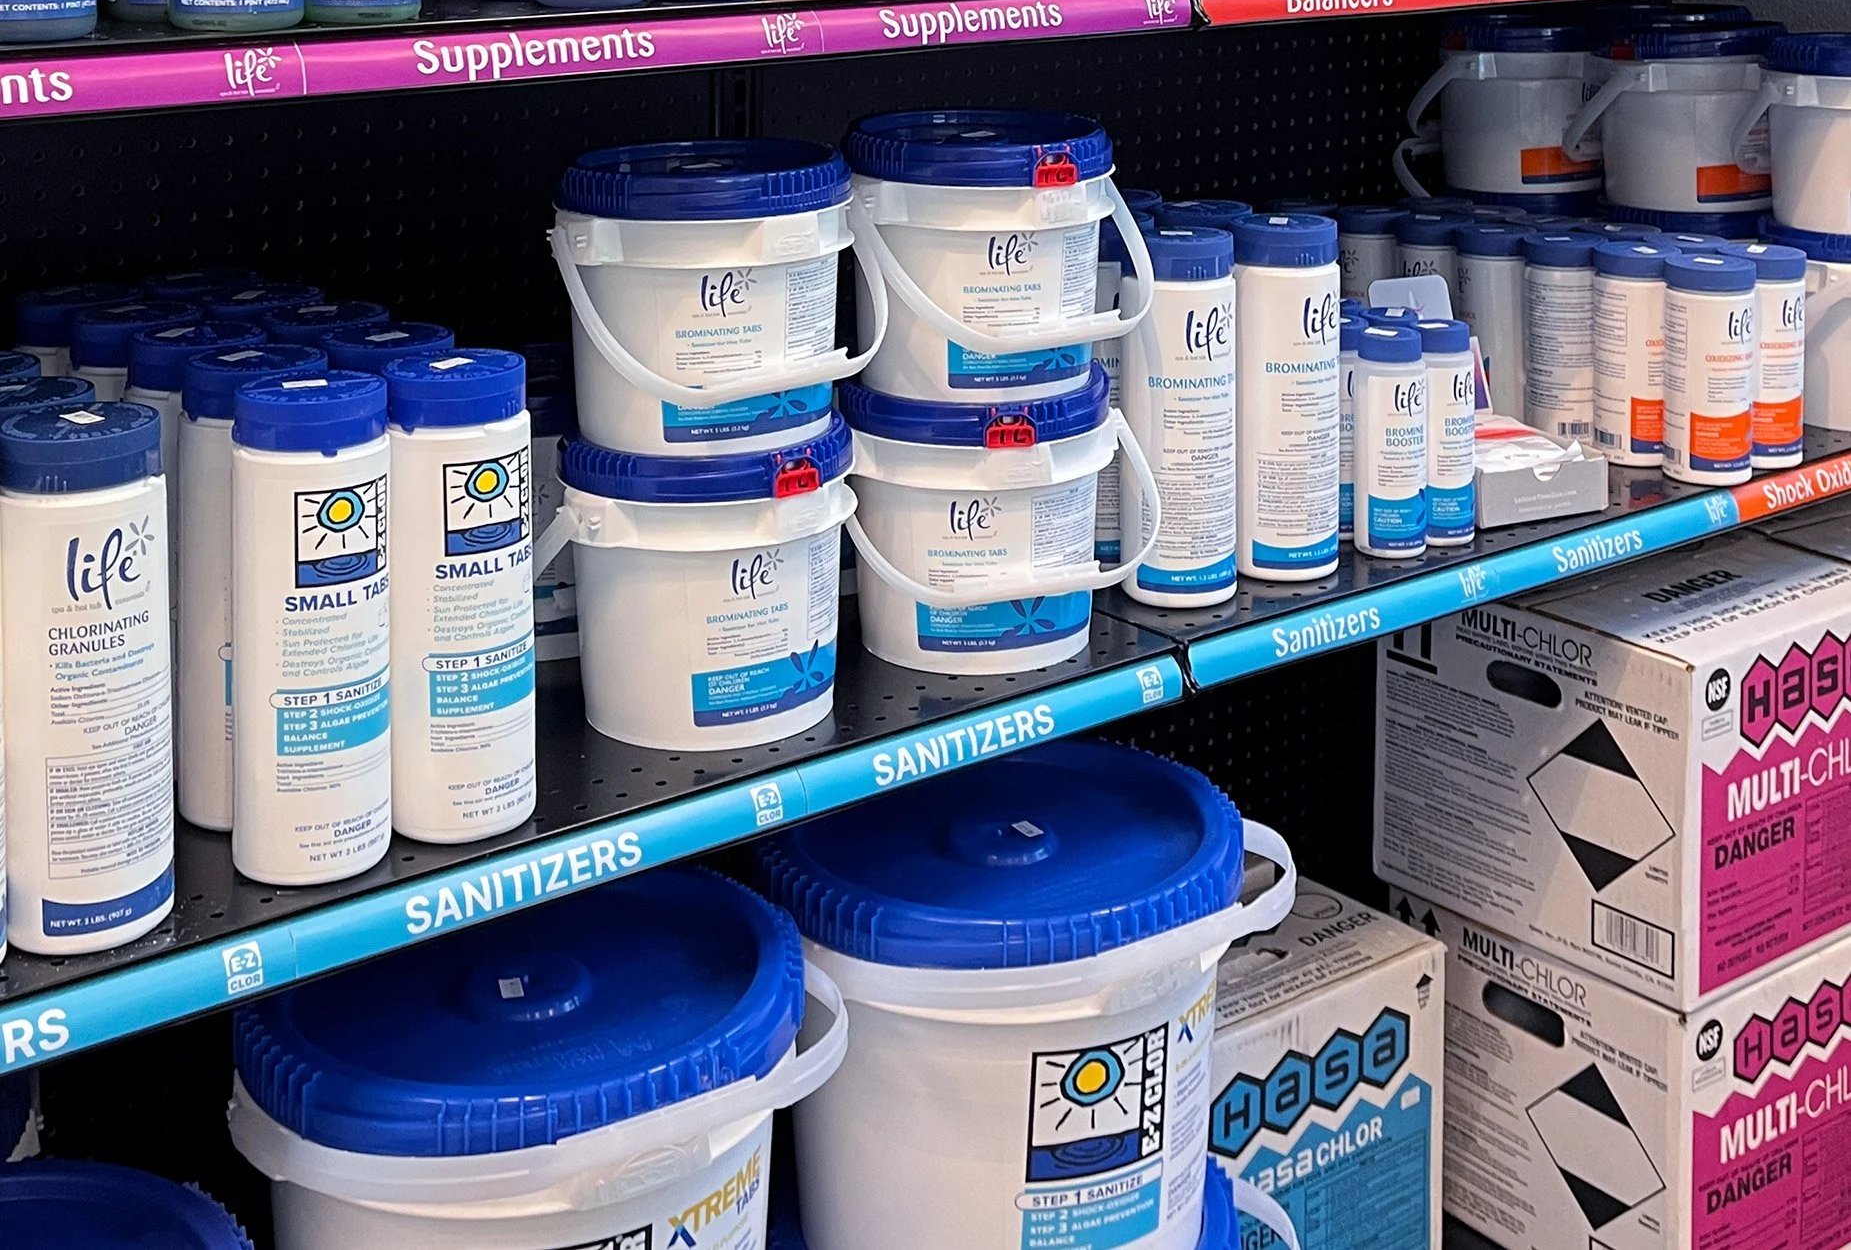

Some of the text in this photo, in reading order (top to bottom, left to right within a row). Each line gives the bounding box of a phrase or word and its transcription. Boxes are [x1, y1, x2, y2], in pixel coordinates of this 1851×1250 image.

[878, 1, 1063, 45] Supplements
[412, 28, 656, 82] Supplements
[988, 234, 1028, 276] life
[700, 270, 746, 317] life
[962, 282, 1042, 295] BROMINATING TABS
[1303, 293, 1338, 346] life
[675, 324, 763, 339] BROMINATING TABS
[1185, 307, 1228, 362] life
[1265, 358, 1336, 374] BROMINATING
[1148, 376, 1227, 390] BROMINATING
[1394, 381, 1422, 418] life
[1307, 433, 1331, 443] DANGER
[1385, 425, 1424, 438] BROMINE
[1385, 436, 1424, 448] BOOSTER
[1190, 452, 1219, 462] DANGER
[1762, 470, 1814, 511] Shock
[950, 500, 990, 541] life
[1373, 517, 1403, 525] CAUTION
[1432, 505, 1461, 514] CAUTION
[927, 547, 1008, 558] BROMINATING TABS
[1552, 527, 1643, 574] Sanitizers
[66, 527, 141, 611] life
[434, 557, 504, 580] SMALL
[731, 554, 774, 600] life
[1641, 568, 1743, 604] DANGER
[284, 590, 359, 613] SMALL
[706, 602, 789, 625] BROMINATING TABS
[929, 614, 963, 624] DANGER
[48, 609, 150, 642] CHLORINATING
[1271, 605, 1381, 659] Sanitizers
[1641, 615, 1714, 640] KEEP THIS
[1655, 630, 1692, 644] KEEP
[48, 633, 126, 657] GRANULES
[1460, 609, 1593, 668] MULTI-CHLOR
[436, 641, 528, 671] STEP 1 SANITIZE
[1455, 633, 1598, 688] PRECAUTIONARY STATEMENTS
[436, 673, 459, 682] STEP
[436, 680, 500, 694] STEP ALGAE
[283, 678, 383, 707] STEP 1 SANITIZE
[436, 695, 479, 705] BALANCE
[708, 683, 746, 696] DANGER
[1143, 689, 1162, 703] CLOR
[1707, 675, 1729, 704] NSF
[283, 710, 307, 719] STEP
[436, 701, 495, 716] SUPPLEMENT
[1625, 701, 1652, 721] VENTED
[123, 714, 158, 736] DANGER
[283, 717, 351, 732] STEP ALGAE
[283, 732, 329, 743] BALANCE
[283, 740, 346, 755] SUPPLEMENT
[872, 702, 1056, 787] SANITIZERS
[484, 776, 521, 797] DANGER
[757, 790, 779, 811] E-Z
[755, 808, 783, 825] CLOR
[333, 819, 373, 839] DANGER
[1713, 816, 1796, 871] DANGER
[405, 829, 643, 936] SANITIZERS
[1298, 910, 1380, 948] DANGER
[229, 951, 259, 974] E-Z
[1462, 925, 1588, 1008] MULTI-CHLOR
[228, 972, 262, 992] CLOR
[1457, 953, 1593, 1028] PRECAUTIONARY STATEMENTS
[1697, 1024, 1721, 1059] NSF
[1031, 1176, 1144, 1209] STEP 1 SANITIZE
[1706, 1151, 1793, 1216] DANGER
[667, 1148, 762, 1249] XTREME
[1030, 1212, 1057, 1223] STEP
[1030, 1223, 1057, 1234] STEP
[1071, 1217, 1102, 1230] ALGAE
[1029, 1234, 1076, 1249] BALANCE
